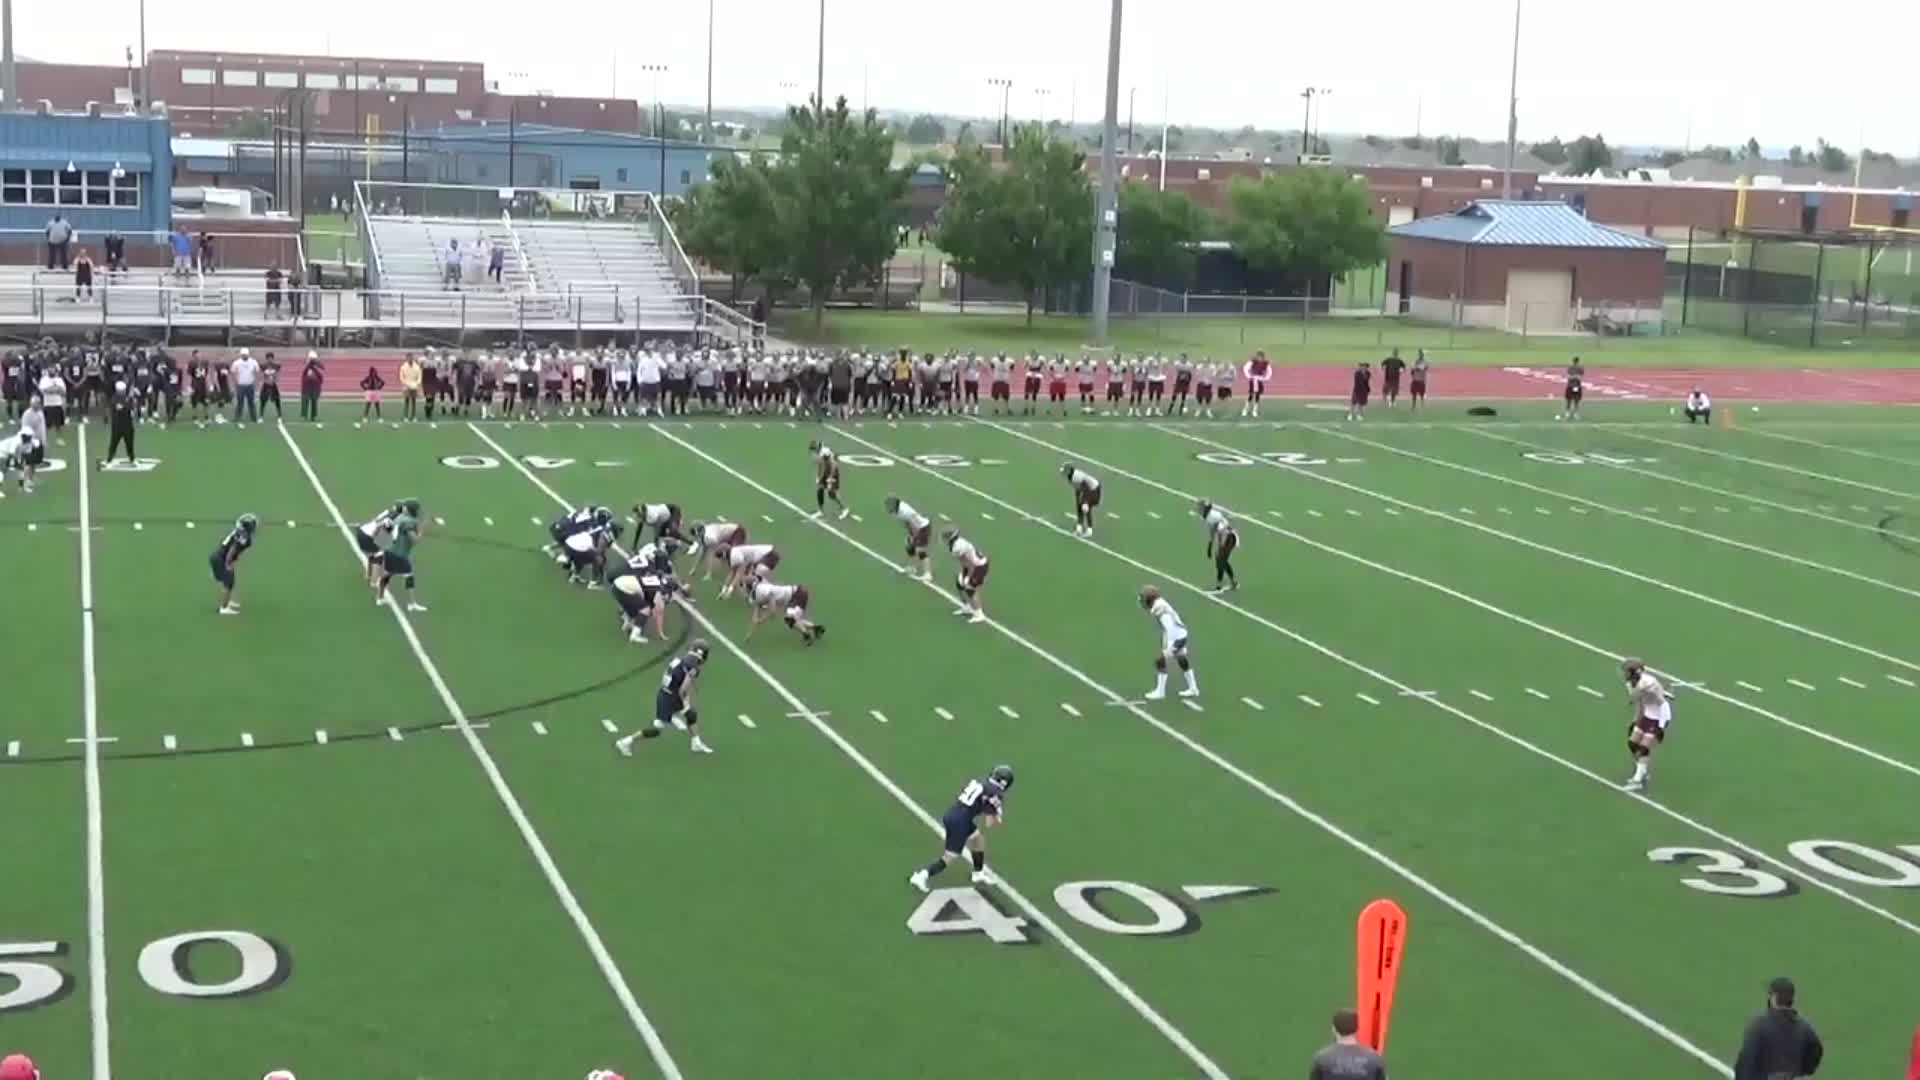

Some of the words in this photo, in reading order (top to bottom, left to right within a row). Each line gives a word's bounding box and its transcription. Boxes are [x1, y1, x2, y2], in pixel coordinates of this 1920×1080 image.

[442, 455, 575, 469] 40
[1647, 839, 1920, 896] 30
[906, 880, 1188, 943] 40
